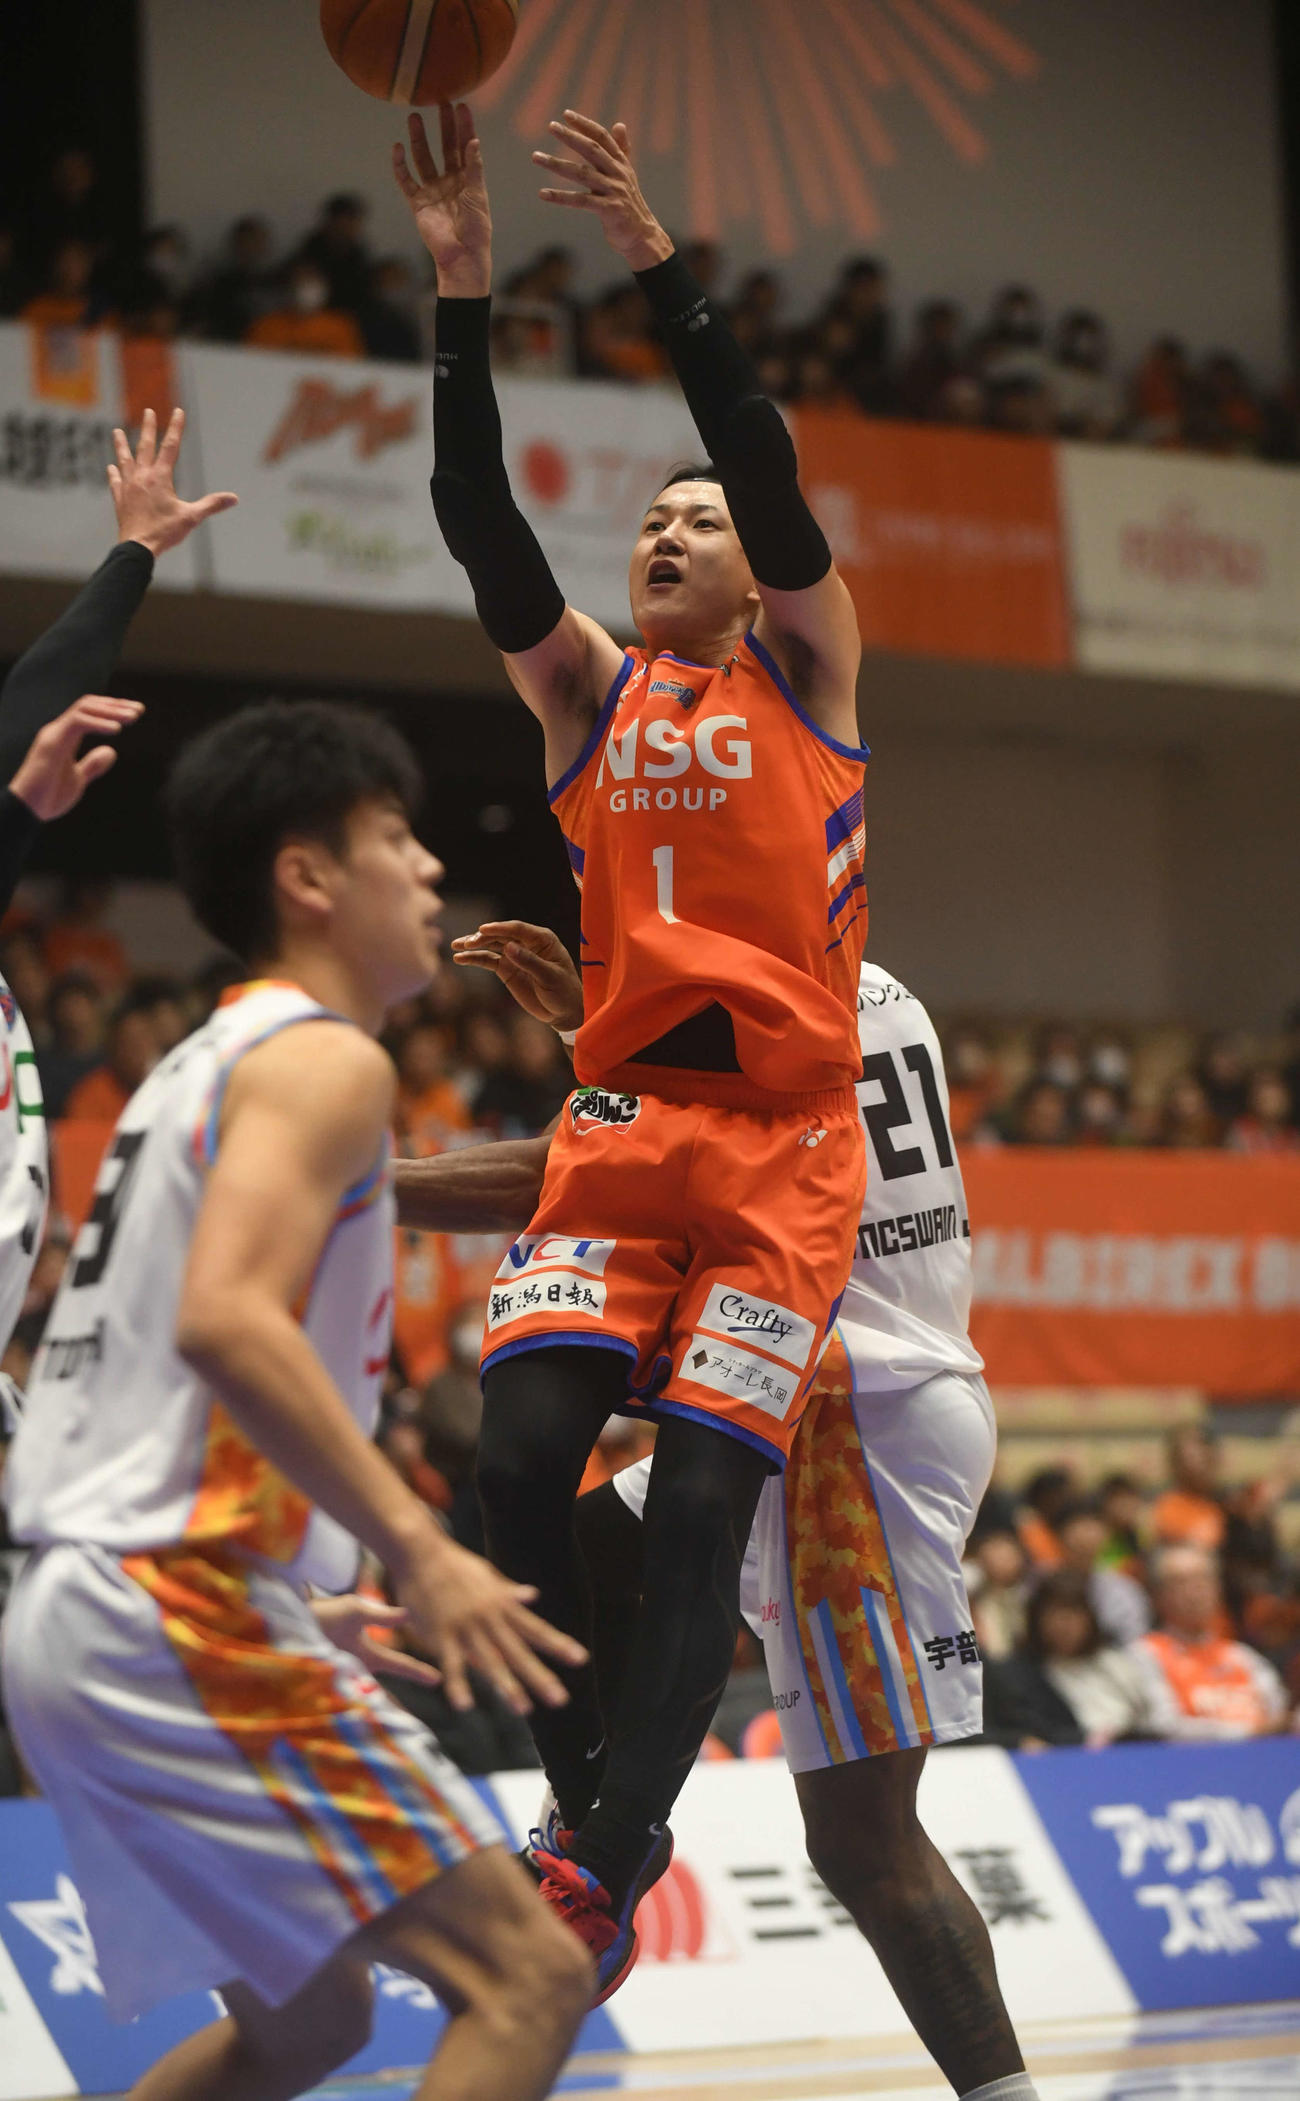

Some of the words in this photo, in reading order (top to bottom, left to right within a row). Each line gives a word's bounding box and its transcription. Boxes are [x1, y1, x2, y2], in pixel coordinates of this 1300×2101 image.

[595, 714, 752, 790] NSG
[609, 787, 727, 813] GROUP
[652, 845, 683, 925] 1
[855, 1043, 954, 1181] 21
[490, 1281, 599, 1322] 新潟日報
[720, 1294, 793, 1344] Crafty
[708, 1356, 788, 1404] アオーレ長岡
[774, 1690, 801, 1711] ROUP
